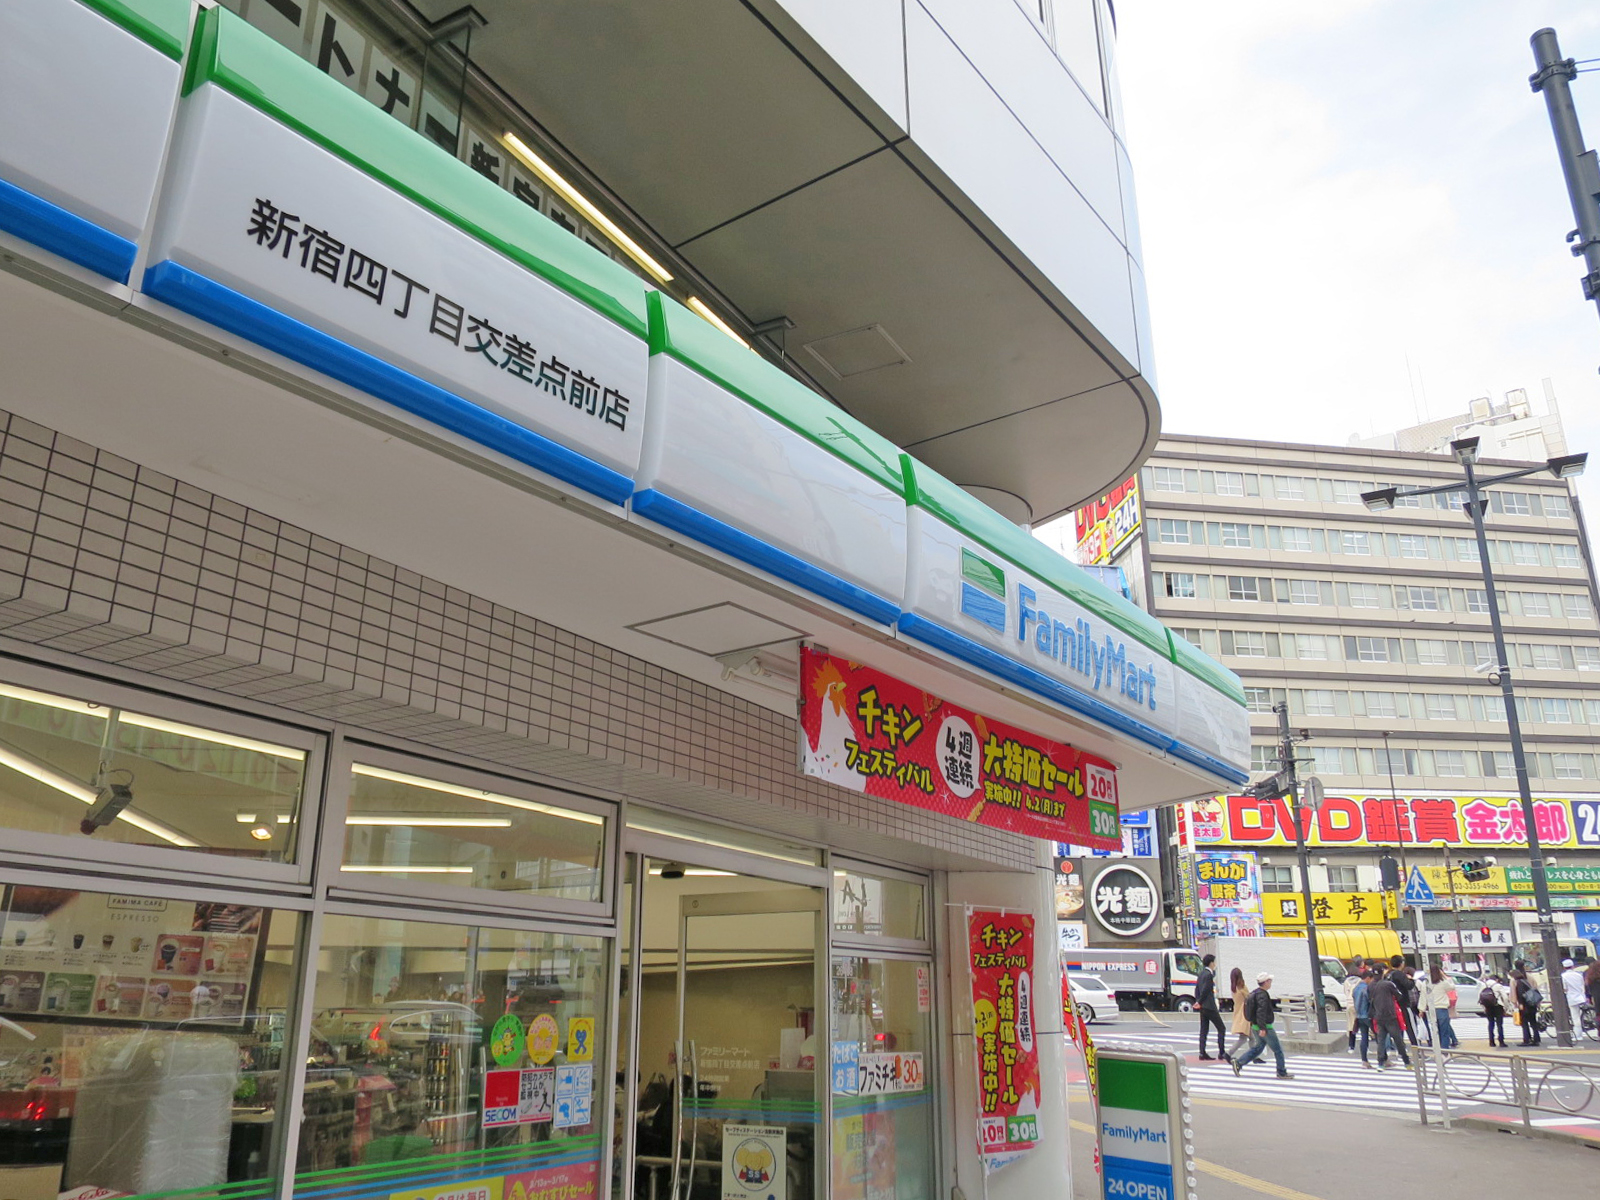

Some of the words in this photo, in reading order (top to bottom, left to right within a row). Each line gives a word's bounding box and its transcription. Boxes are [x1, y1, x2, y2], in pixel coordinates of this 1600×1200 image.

[246, 198, 630, 432] 新宿四丁目交差点前店
[1018, 582, 1156, 710] FamilyMart
[856, 684, 924, 747] チキン
[945, 727, 973, 759] 4週
[844, 738, 935, 794] フェスティバル
[944, 755, 974, 790] 連続
[983, 732, 1085, 799] 大特価セール
[1193, 827, 1222, 838] 金太郎
[1227, 796, 1460, 842] DVD鑑賞
[1464, 801, 1567, 842] 金太郎
[1578, 803, 1600, 841] 2
[1198, 861, 1246, 881] まんが
[1509, 869, 1600, 880] 疲れとレスを心身とも
[1210, 883, 1237, 899] 喫茶
[110, 913, 160, 923] ESPRESSO
[981, 922, 1024, 951] チキン
[1400, 932, 1444, 945] おば
[974, 952, 1027, 969] フェスティバル
[1081, 961, 1106, 972] NIPPON
[1107, 962, 1136, 972] EXPRESS
[997, 972, 1019, 1105] 大特価セール
[982, 1031, 999, 1113] 実施中!!
[485, 1108, 517, 1123] SECOM
[1102, 1122, 1167, 1144] FamilyMart
